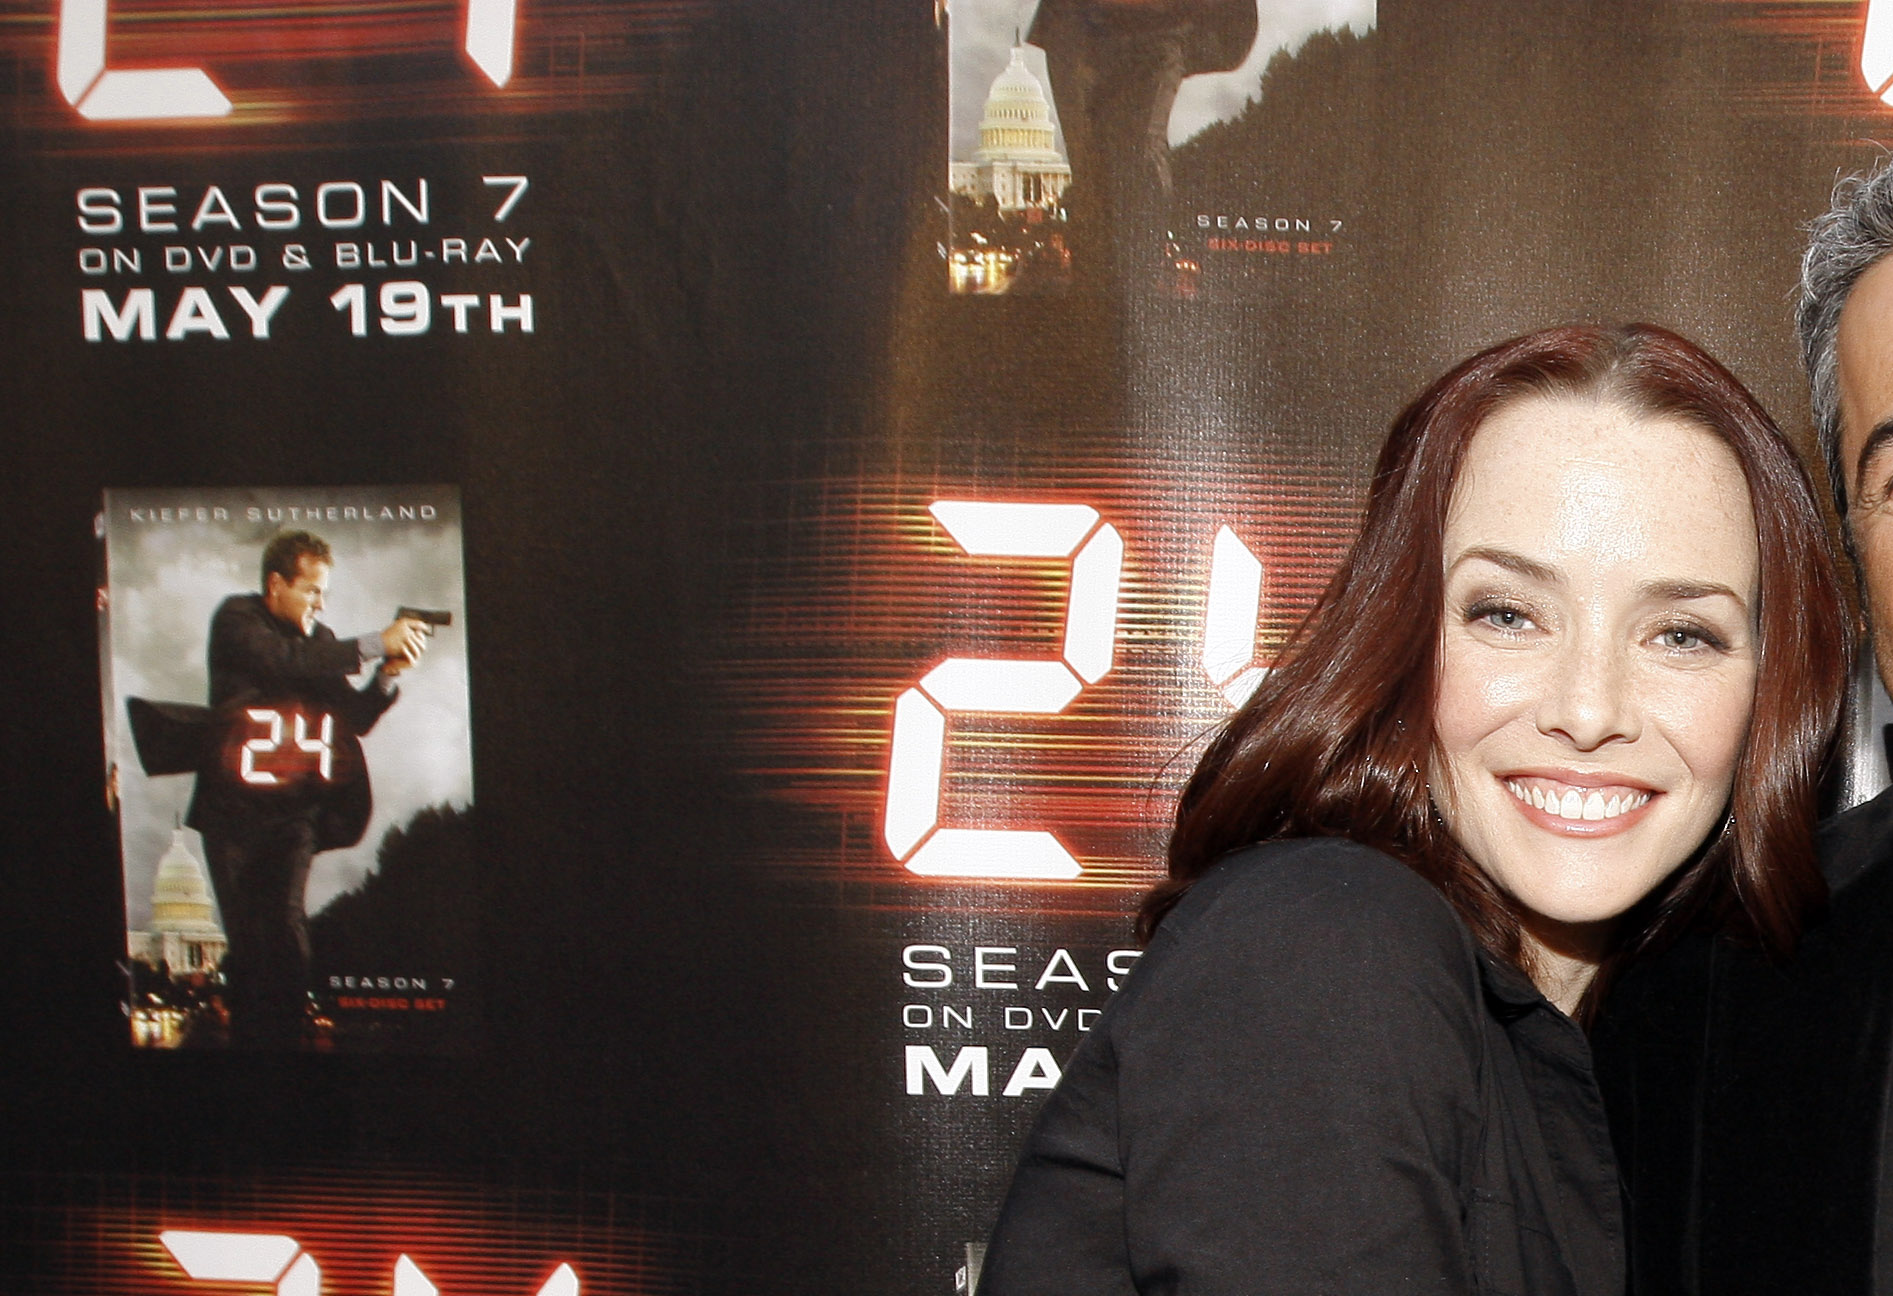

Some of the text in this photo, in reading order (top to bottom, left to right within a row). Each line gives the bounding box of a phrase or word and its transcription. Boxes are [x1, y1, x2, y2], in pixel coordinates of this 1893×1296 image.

[77, 175, 529, 234] SEASON 7
[1197, 214, 1342, 232] SEASON 7
[79, 237, 530, 274] ON DVD & BLU-RAY
[82, 281, 534, 342] MAY 19TH
[129, 504, 437, 522] KIEFER SUTHERLAND
[240, 709, 334, 784] 24
[329, 975, 455, 991] SEASON 7
[902, 1004, 973, 1029] ON
